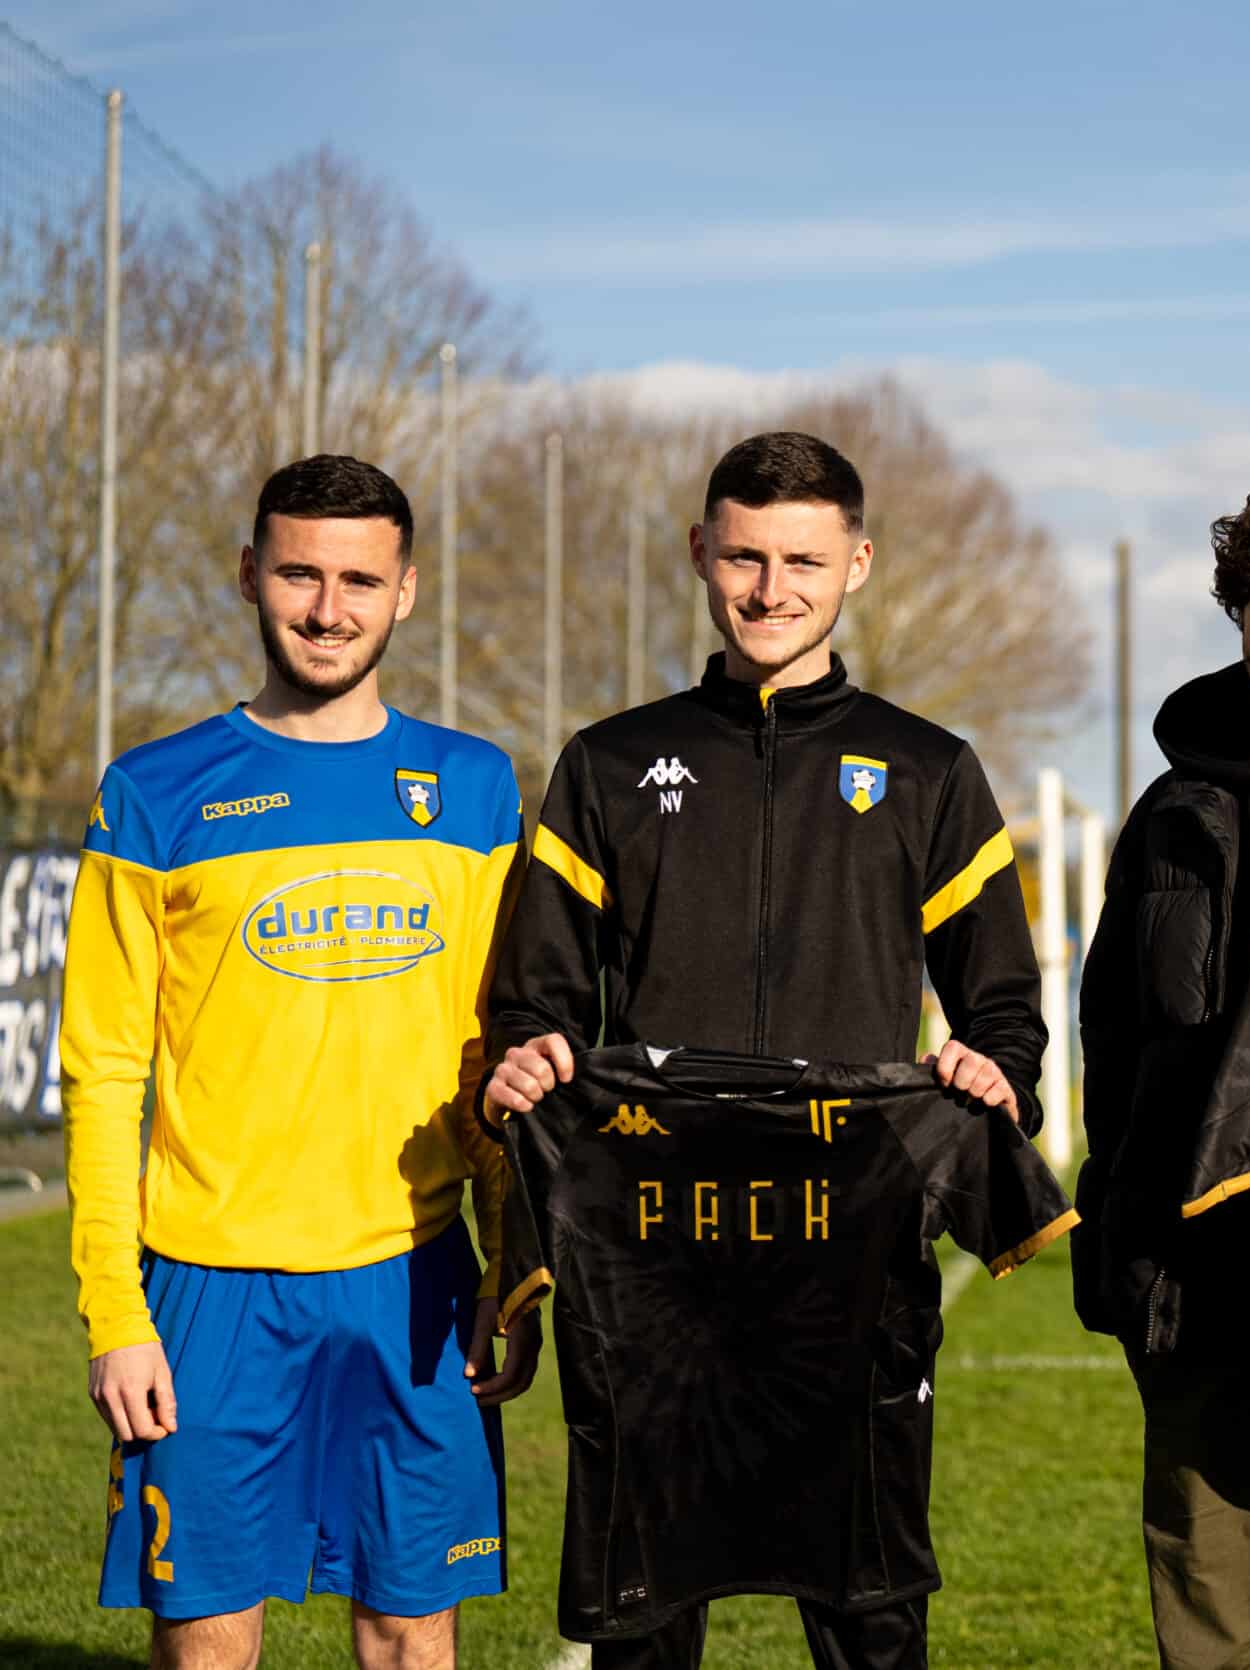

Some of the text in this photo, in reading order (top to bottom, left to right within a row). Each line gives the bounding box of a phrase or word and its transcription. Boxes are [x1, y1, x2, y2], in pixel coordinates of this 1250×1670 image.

[202, 792, 290, 821] Kappa
[660, 790, 683, 814] NV
[257, 902, 430, 939] durand
[638, 1179, 829, 1241] PACK
[143, 1485, 174, 1582] 2
